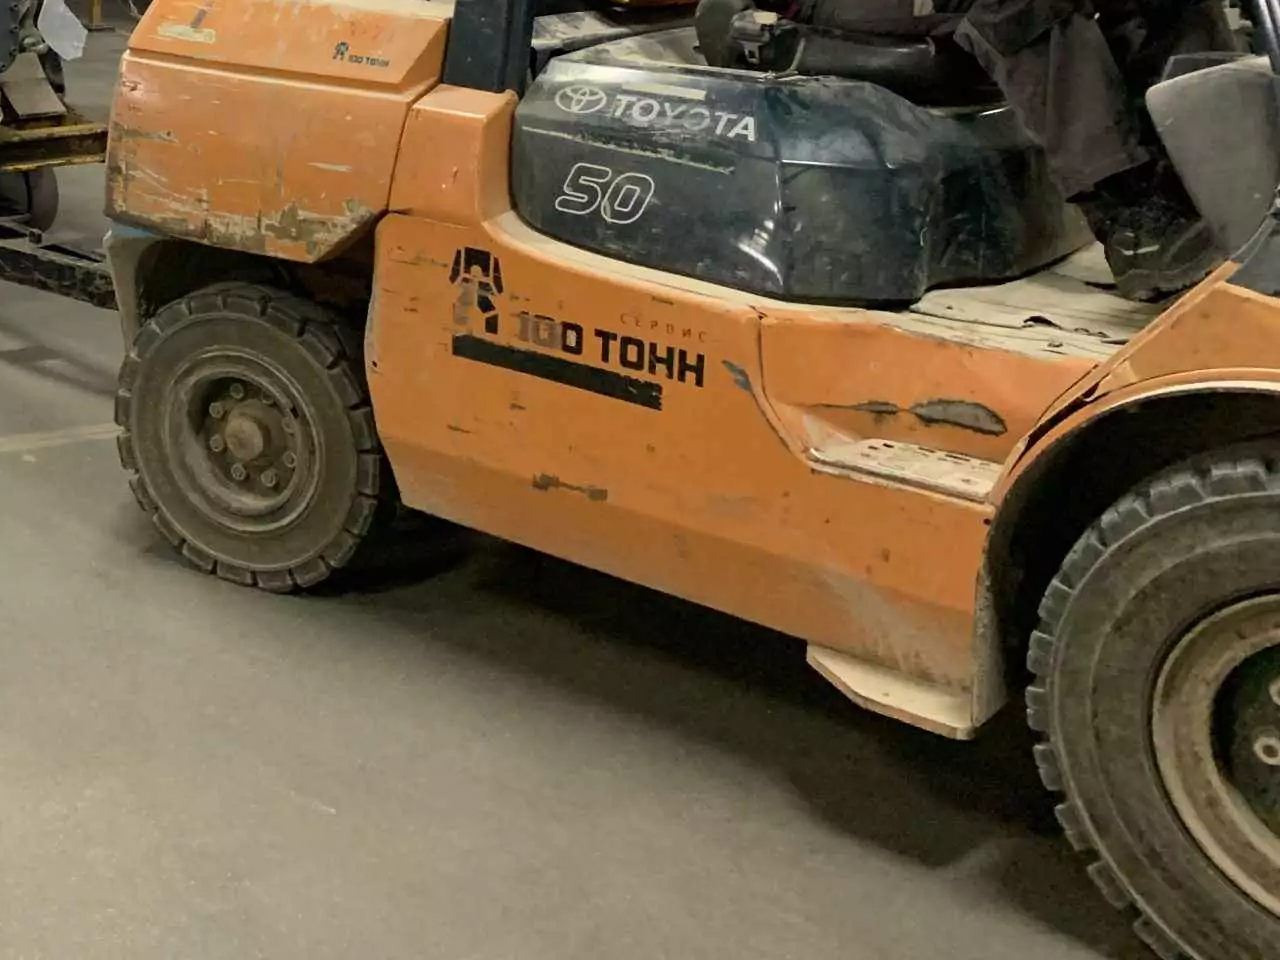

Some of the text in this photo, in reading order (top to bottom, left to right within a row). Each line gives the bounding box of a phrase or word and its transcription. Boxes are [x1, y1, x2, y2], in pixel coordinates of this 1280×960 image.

[613, 94, 757, 142] TOYOTA
[554, 162, 655, 225] 50
[518, 310, 706, 388] 100 ТОНН
